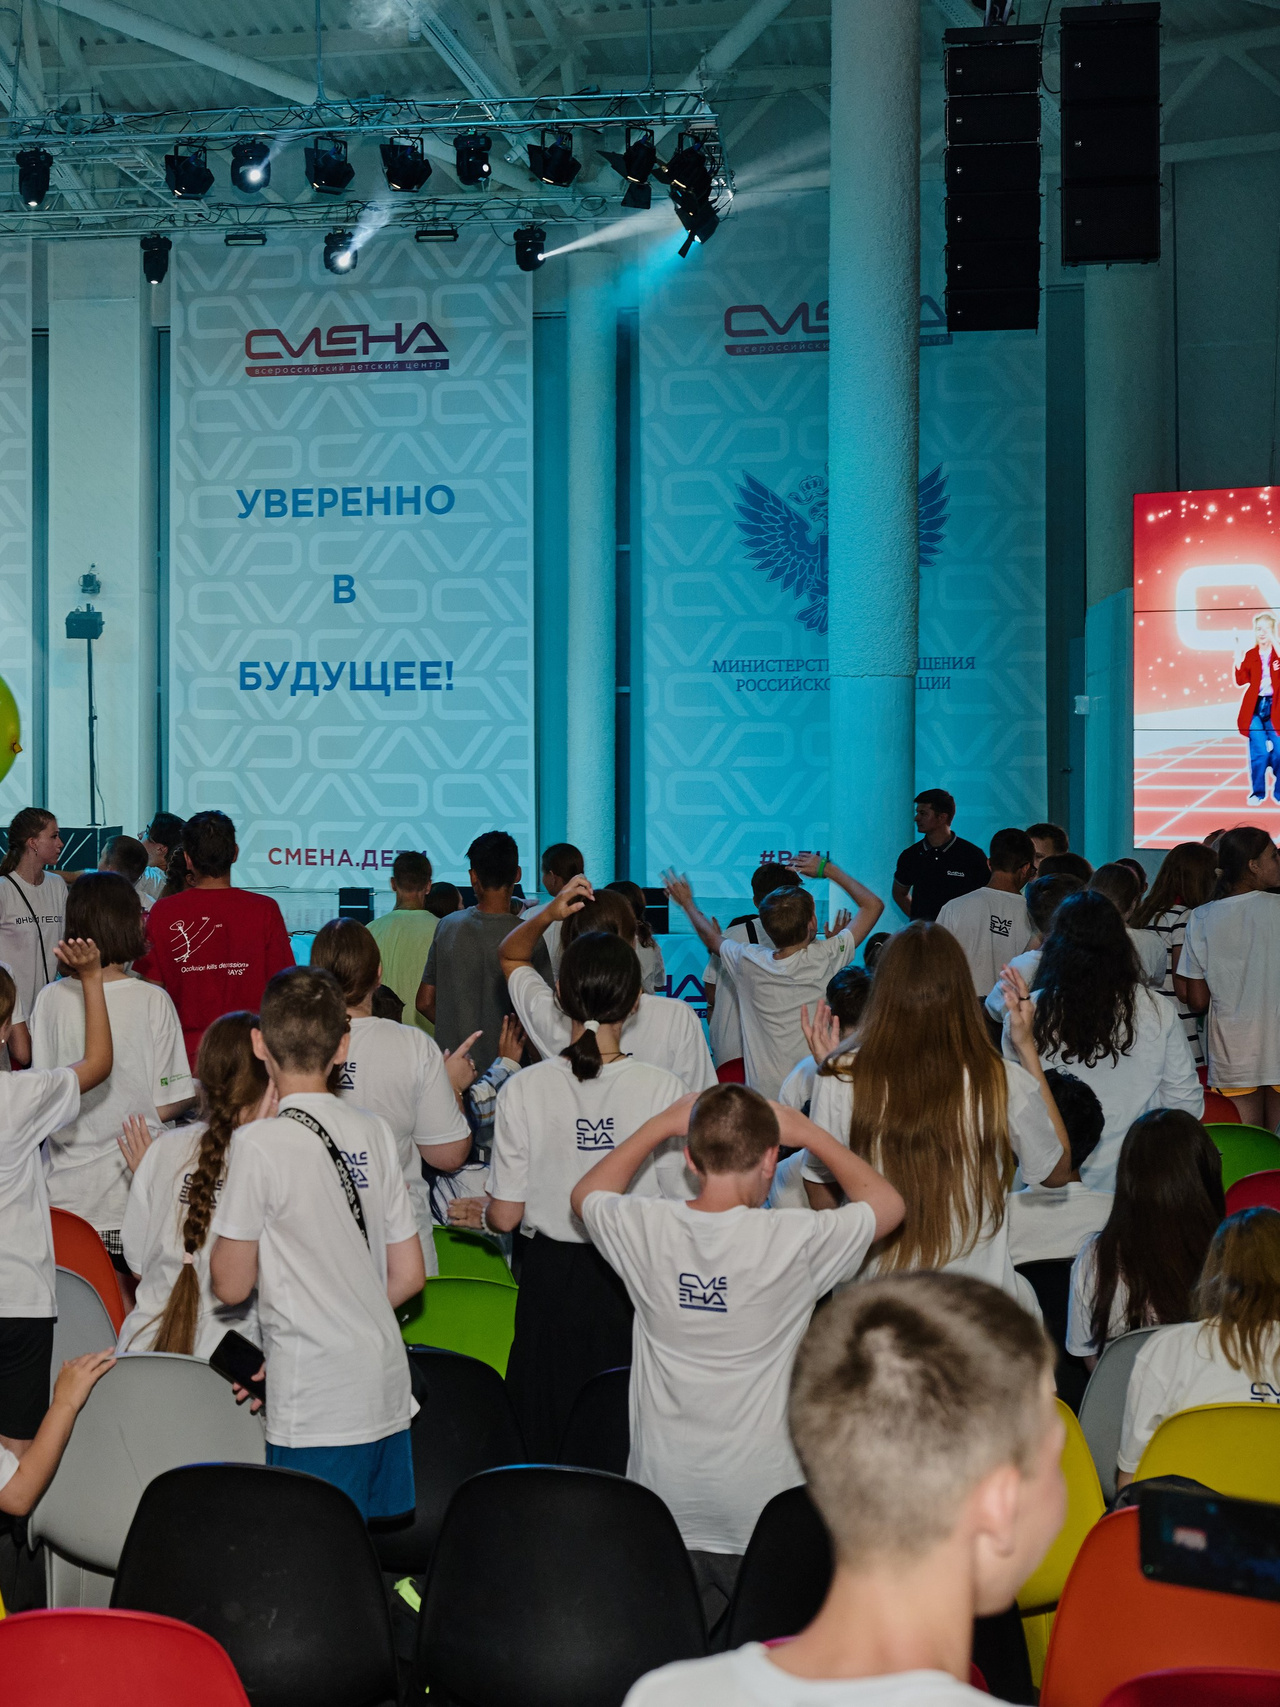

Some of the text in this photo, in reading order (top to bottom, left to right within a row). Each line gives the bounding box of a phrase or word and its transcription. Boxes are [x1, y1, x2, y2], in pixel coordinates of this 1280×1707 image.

[724, 295, 948, 337] СМА
[245, 321, 449, 360] СМЕНА
[736, 341, 829, 354] всероссийски
[255, 360, 442, 375] всероссийский детский центр
[236, 484, 455, 519] УВЕРЕННО
[333, 574, 356, 604] В
[239, 661, 454, 697] БУДУЩЕЕ!
[712, 658, 829, 673] МИНИСТЕРСТ
[268, 847, 426, 870] СМЕНА.ДЕ
